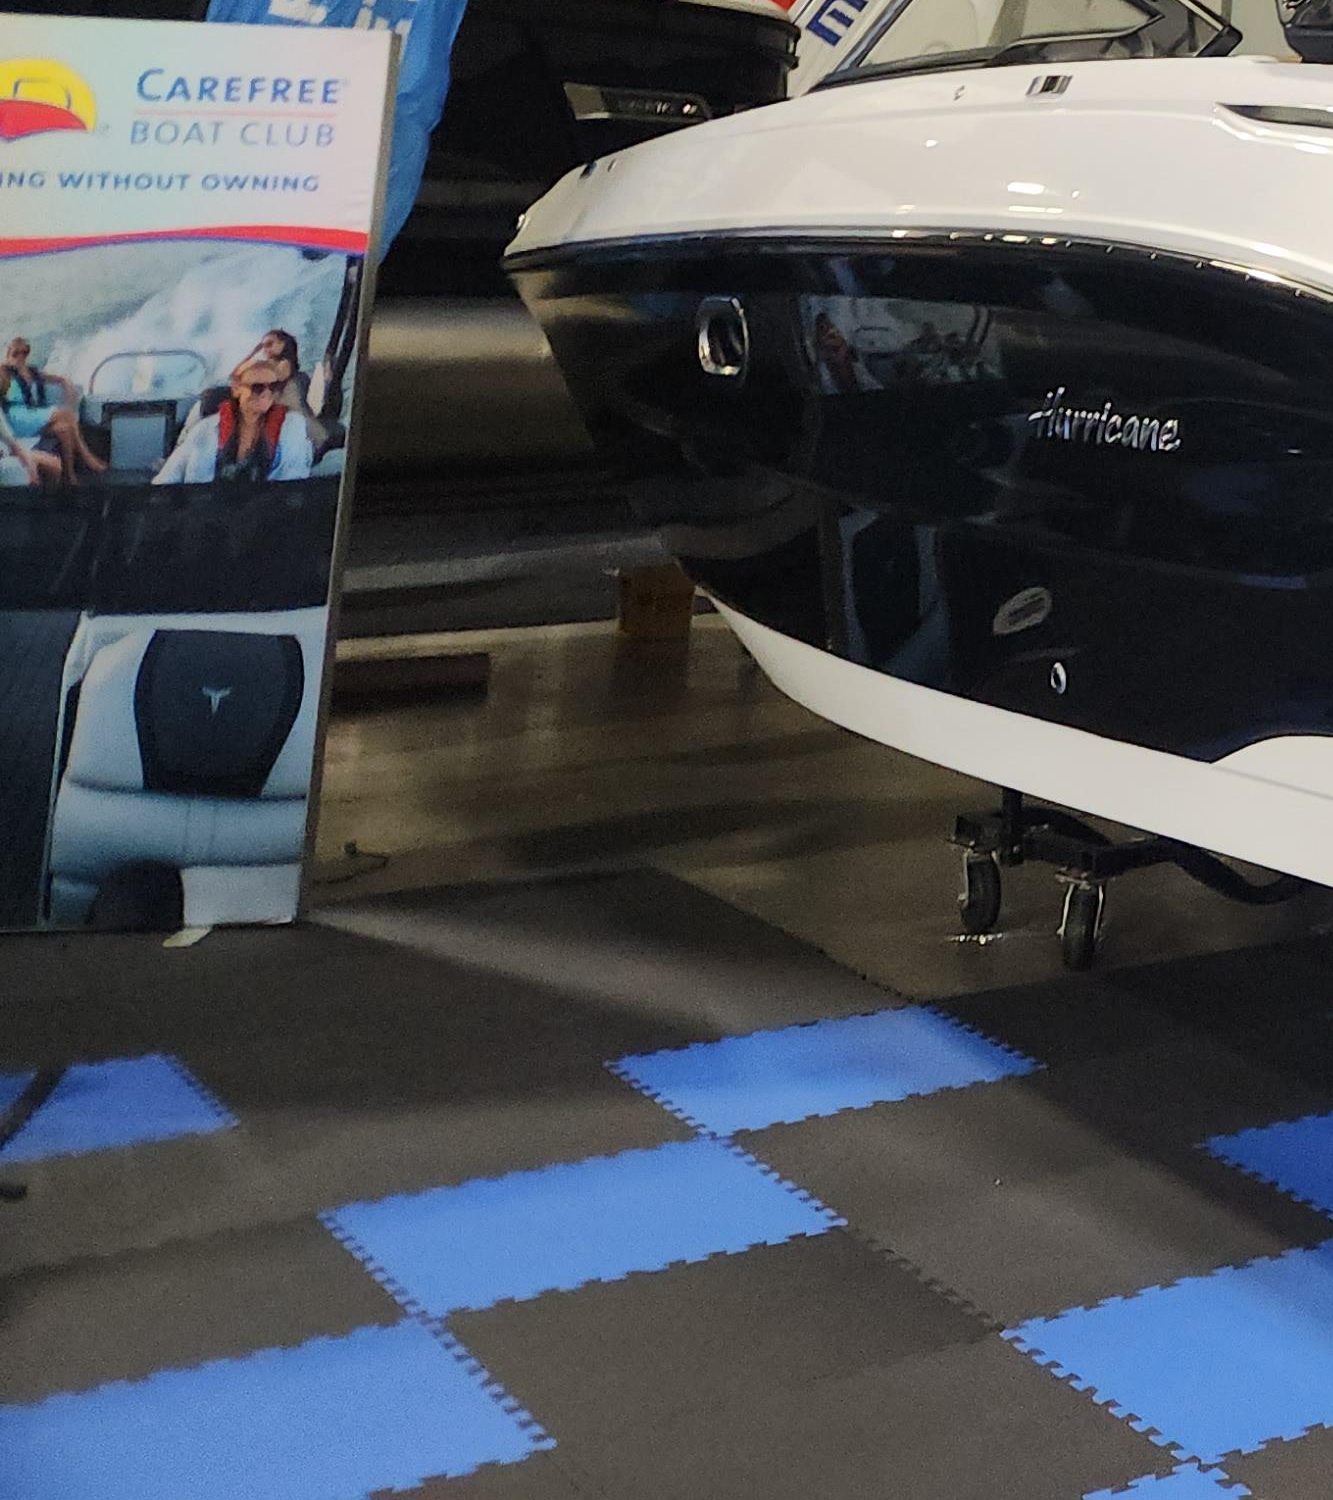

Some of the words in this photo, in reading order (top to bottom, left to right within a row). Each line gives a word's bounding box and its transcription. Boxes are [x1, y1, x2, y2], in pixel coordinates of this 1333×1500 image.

[137, 68, 340, 104] CAREFREE
[130, 120, 224, 146] BOAT
[240, 121, 335, 147] CLUB
[59, 172, 191, 191] WITHOUT
[201, 173, 320, 192] OWNING
